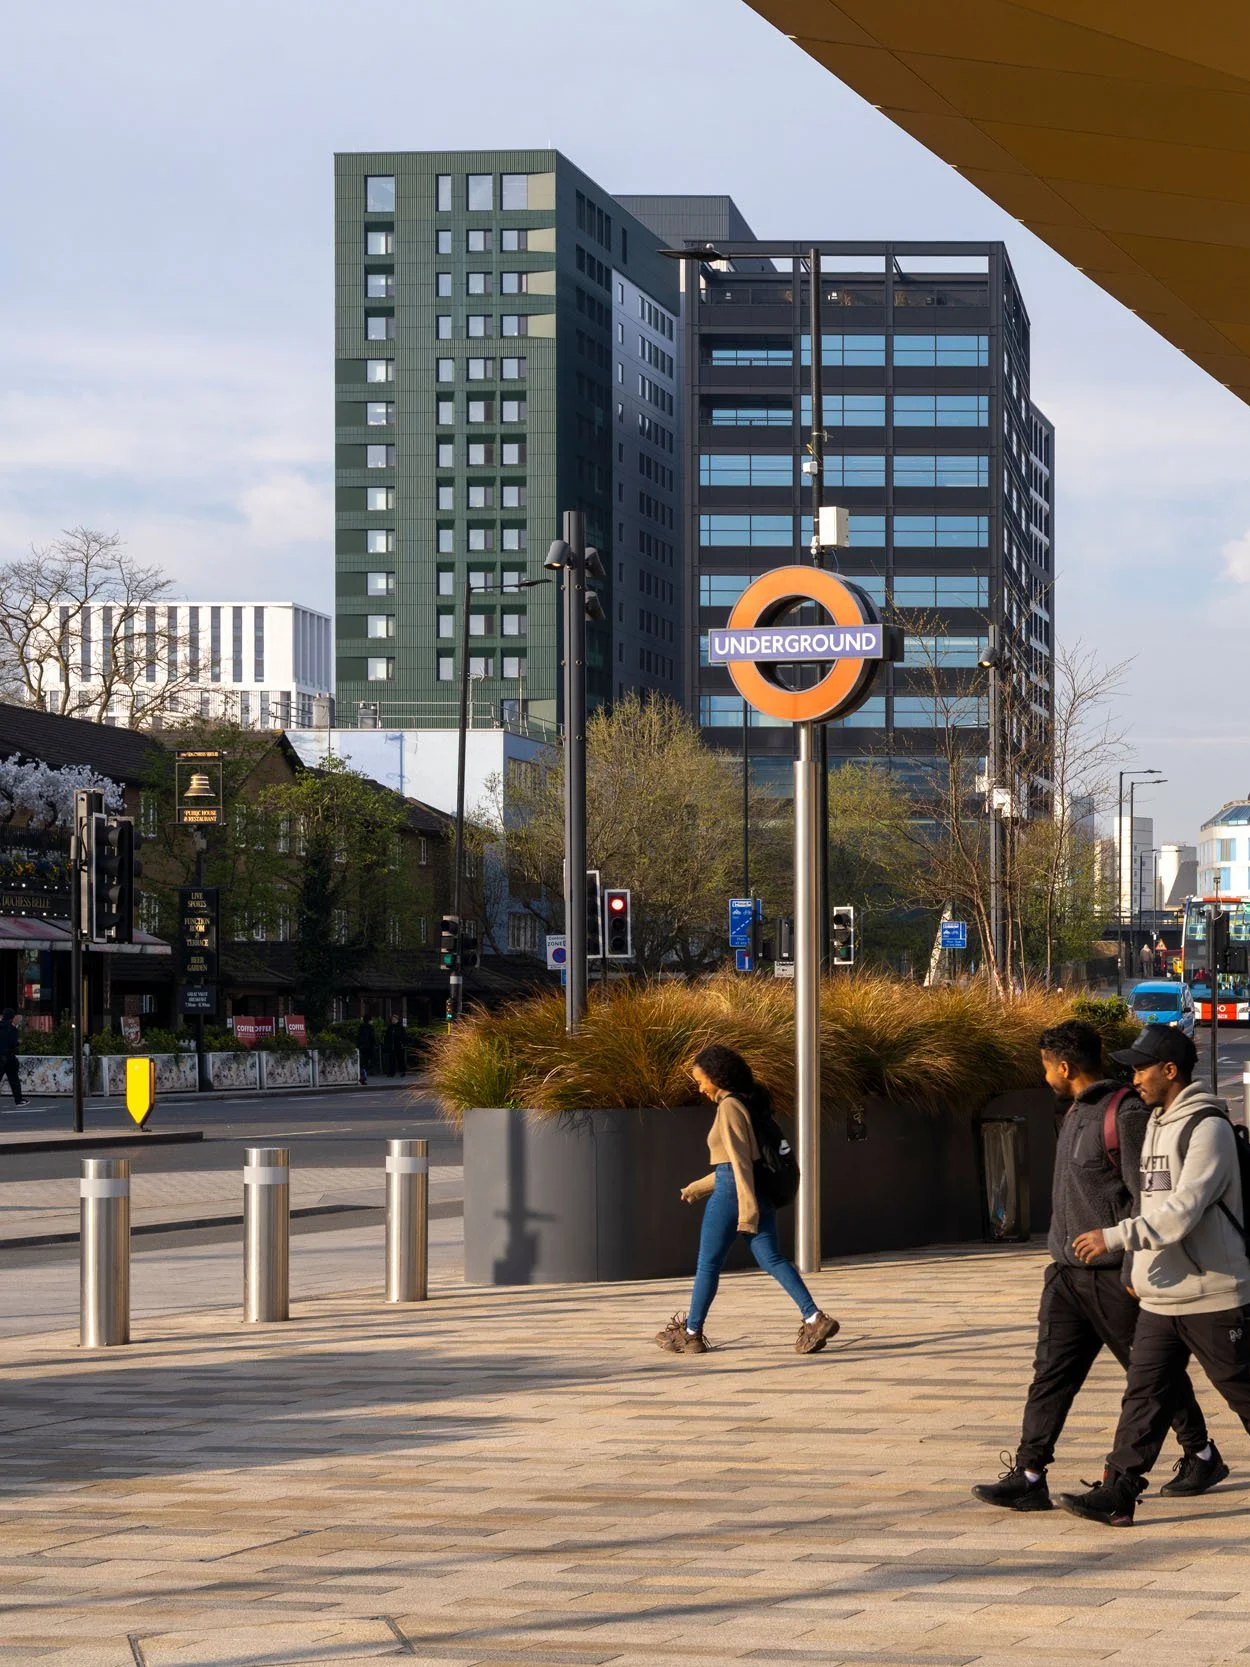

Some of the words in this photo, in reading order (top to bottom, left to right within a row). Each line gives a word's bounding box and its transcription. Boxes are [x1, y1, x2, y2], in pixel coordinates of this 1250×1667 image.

[714, 632, 877, 656] UNDERGROUND
[237, 1025, 255, 1033] COFFEE
[288, 1023, 305, 1031] COFFEE
